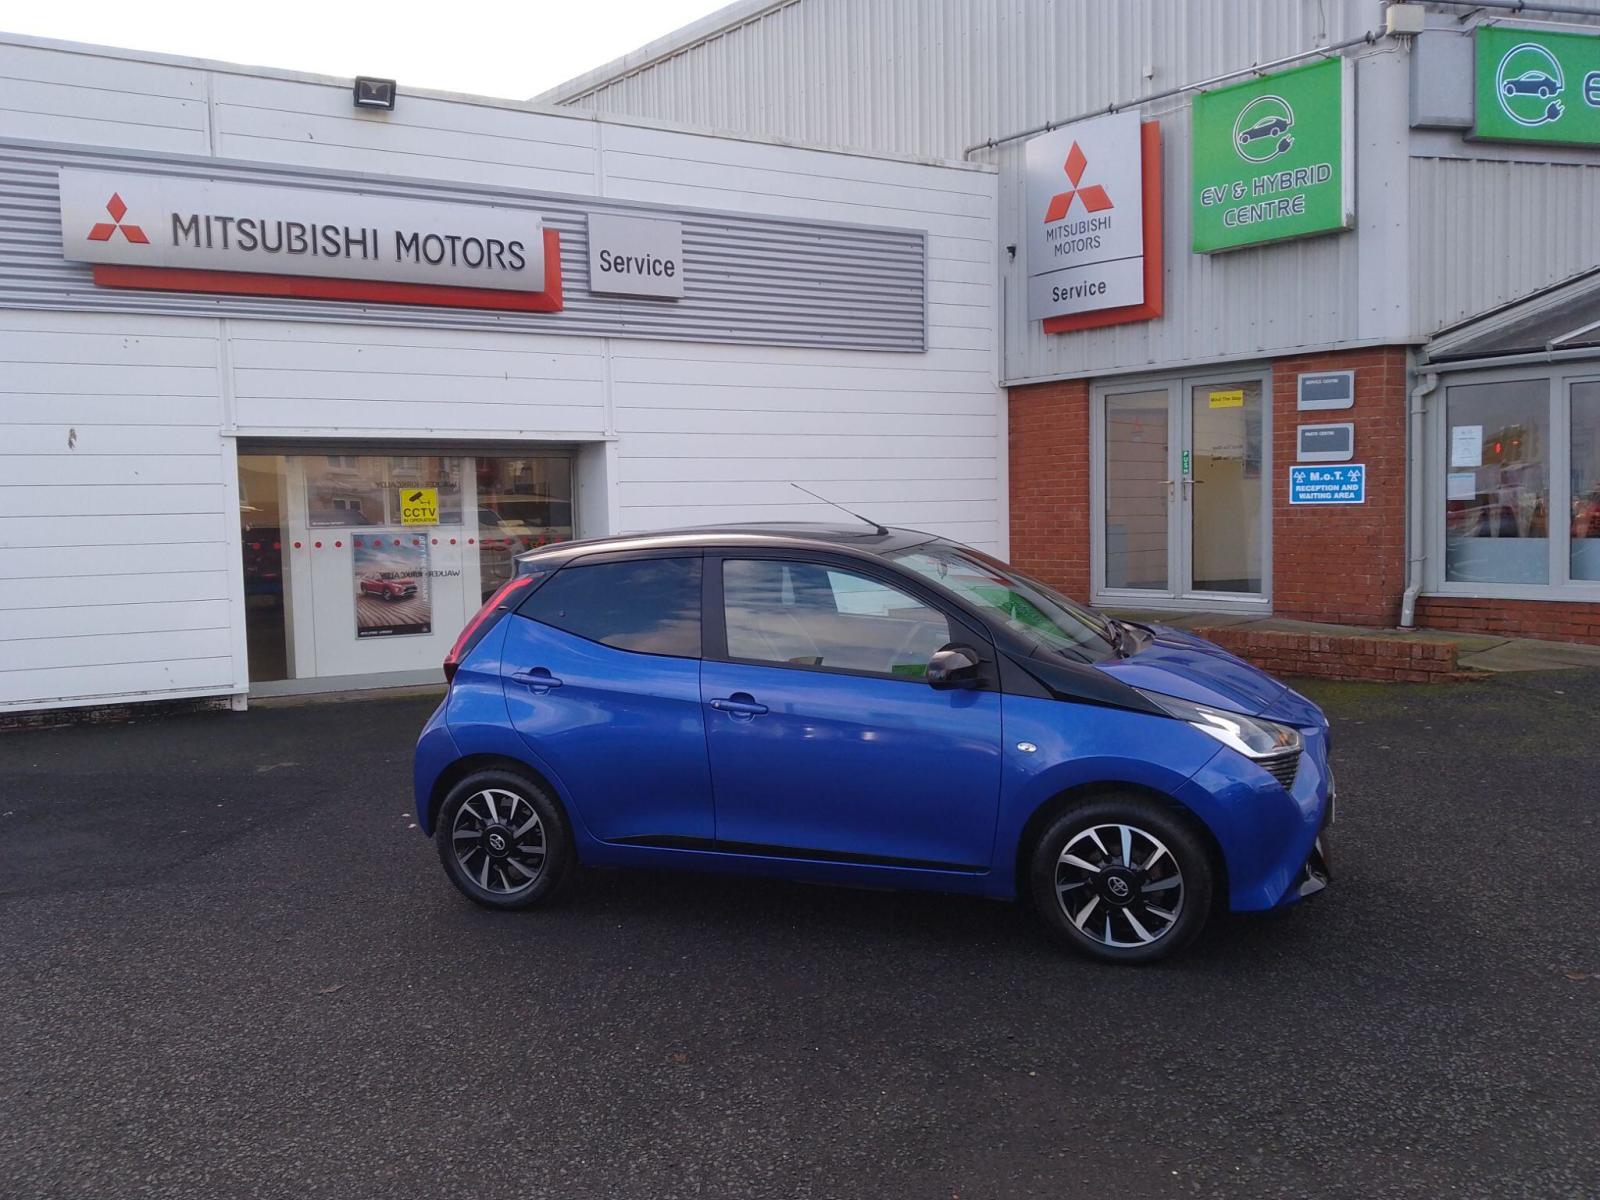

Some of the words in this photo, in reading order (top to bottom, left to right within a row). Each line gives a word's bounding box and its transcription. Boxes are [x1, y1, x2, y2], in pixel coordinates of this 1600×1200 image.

[1200, 184, 1228, 208] EV
[1231, 180, 1247, 200] &
[1252, 162, 1332, 197] HYBRID
[1223, 194, 1305, 228] CENTRE
[1046, 216, 1112, 242] MITSUBISHI
[172, 212, 379, 260] MITSUBISHI
[395, 230, 526, 271] MOTORS
[1054, 235, 1101, 257] MOTORS
[599, 250, 676, 278] Service
[1052, 280, 1107, 303] Service
[1295, 484, 1340, 492] RECEPTION
[1341, 483, 1359, 491] AND
[1309, 471, 1344, 481] M.o.T.
[1333, 491, 1356, 499] AREA
[403, 507, 436, 518] CCTV
